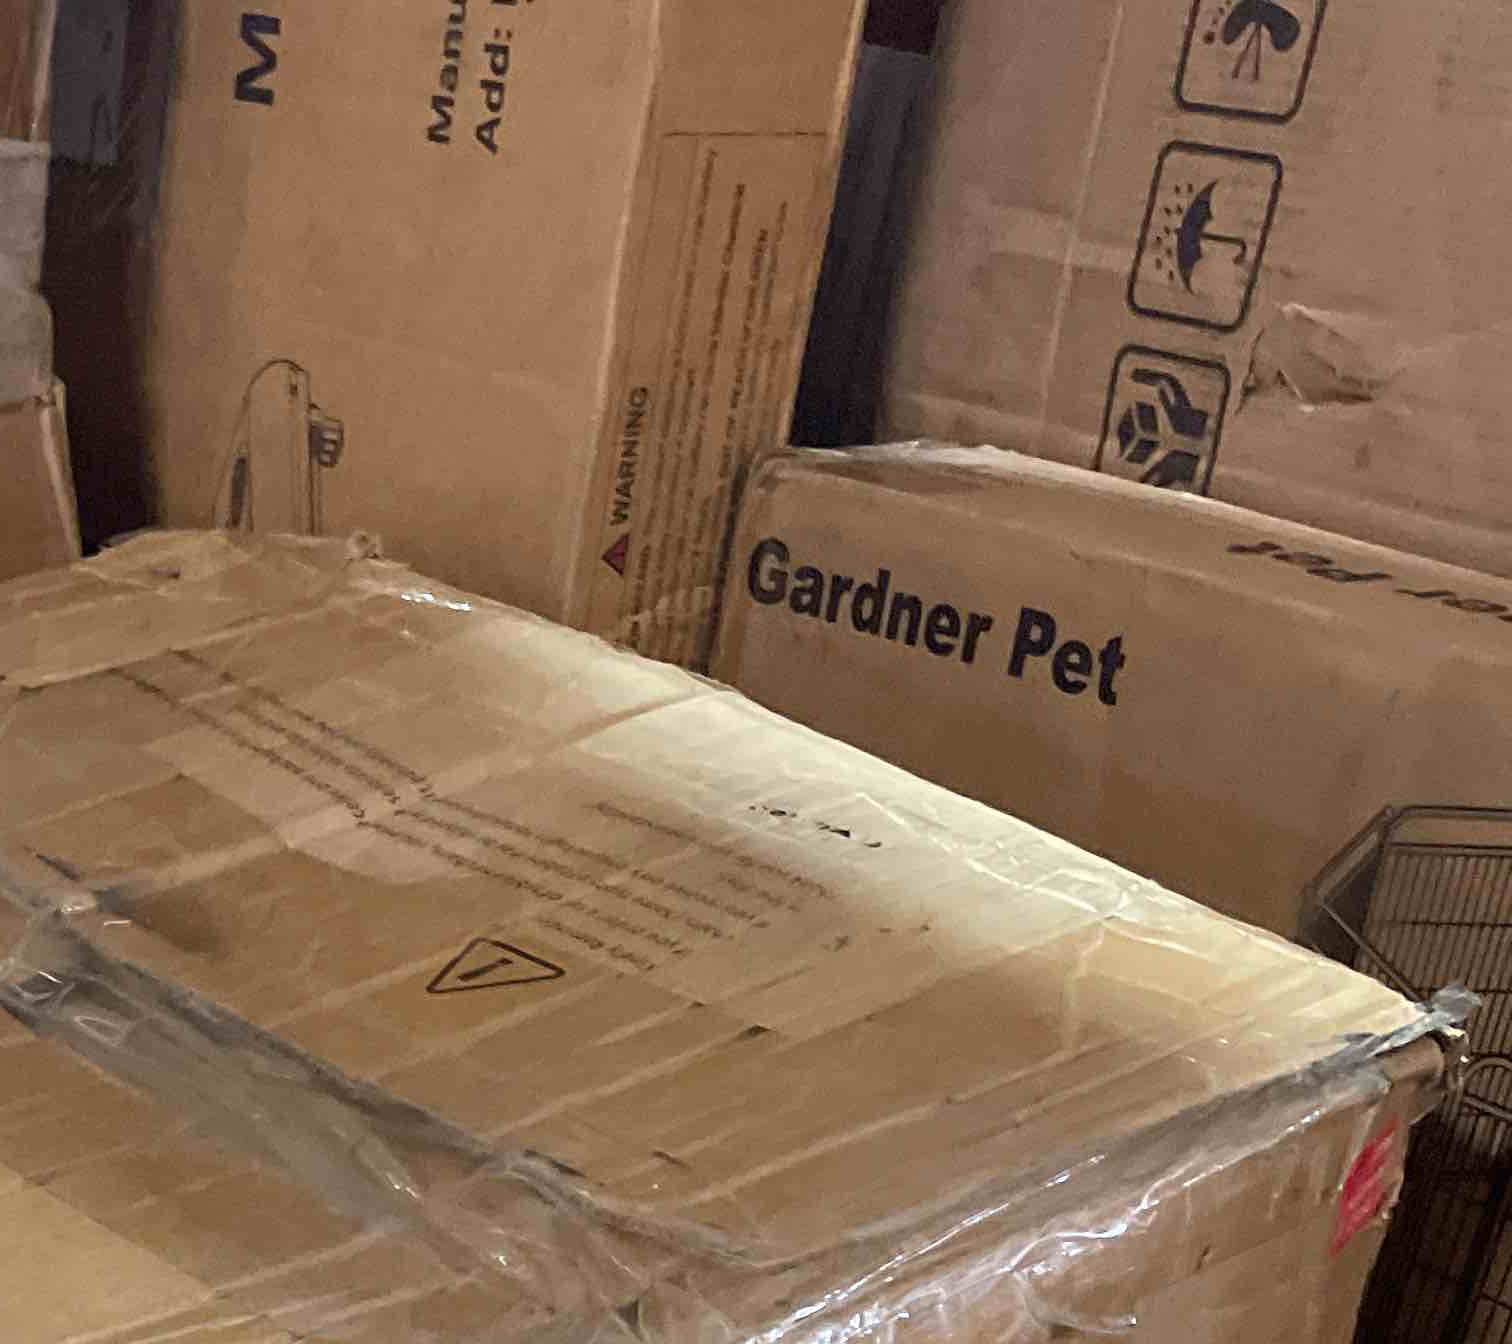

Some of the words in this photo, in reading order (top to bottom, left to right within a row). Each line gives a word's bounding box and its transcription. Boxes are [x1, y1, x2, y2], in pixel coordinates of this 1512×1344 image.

[474, 25, 514, 154] Add:
[609, 385, 650, 526] WARNING
[747, 536, 992, 668] Gardner
[1007, 607, 1127, 707] Pet
